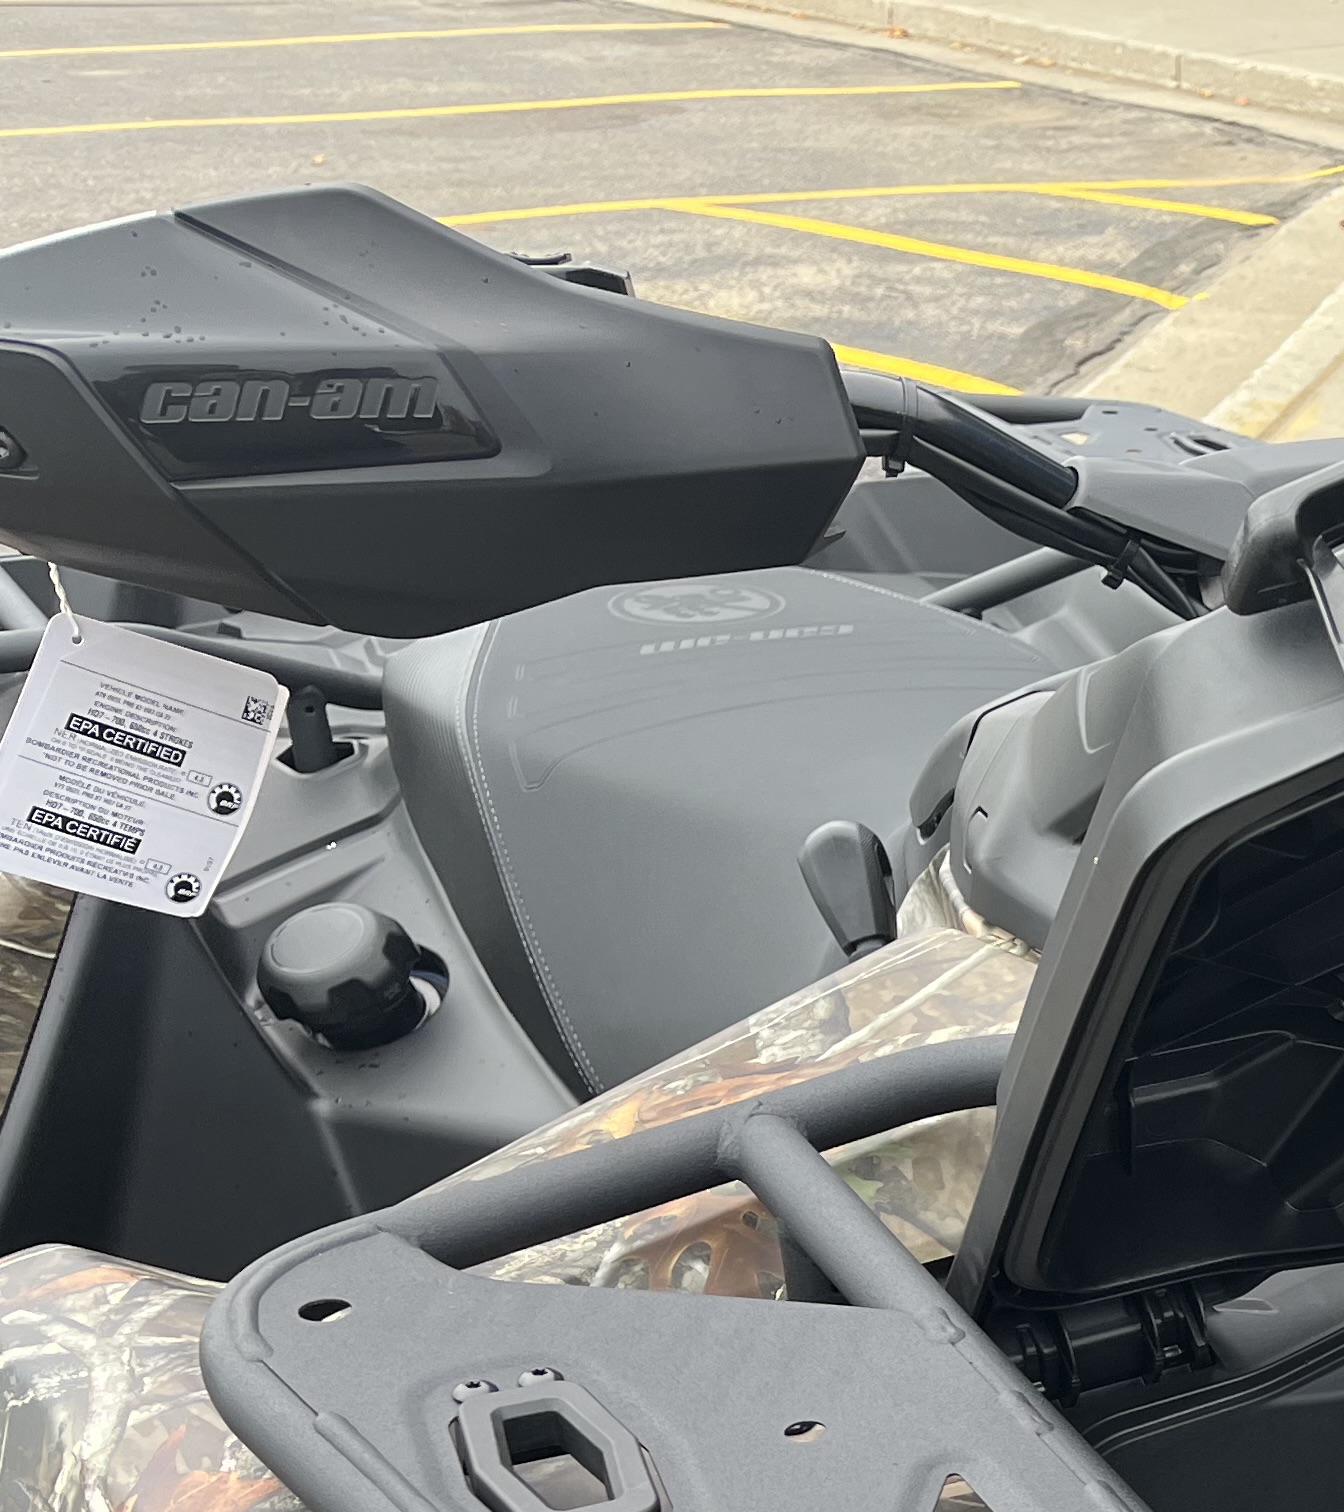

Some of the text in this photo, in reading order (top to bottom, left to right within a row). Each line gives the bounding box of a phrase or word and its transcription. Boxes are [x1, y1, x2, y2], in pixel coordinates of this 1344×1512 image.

[140, 376, 440, 425] can-am
[93, 700, 123, 714] ENGINE
[99, 682, 133, 697] VEHICLE
[133, 693, 161, 707] MODEL
[52, 727, 77, 741] NER
[68, 716, 184, 764] EPA CERTIFIED
[152, 729, 158, 737] 4
[158, 731, 194, 749] STROKES
[25, 737, 81, 760] BOMBARDIER
[80, 755, 142, 780] RECREATIONAL
[141, 775, 185, 793] PRODUCTS
[64, 759, 75, 767] TO
[76, 763, 88, 771] BE
[87, 766, 129, 784] REMOVED
[128, 780, 154, 792] PRIOR
[92, 786, 105, 794] DU
[41, 789, 97, 810] DESCRIPTION
[97, 806, 110, 814] DU
[110, 811, 144, 825] MOTEUR
[9, 817, 32, 831] TEN
[30, 809, 137, 851] EPA CERTIFIÉ
[117, 821, 146, 836] TEMPS
[11, 846, 30, 855] PAS
[29, 851, 69, 868] ENLEVER
[68, 863, 95, 876] AVANT
[96, 872, 107, 880] LA
[43, 847, 86, 864] PRODUITS
